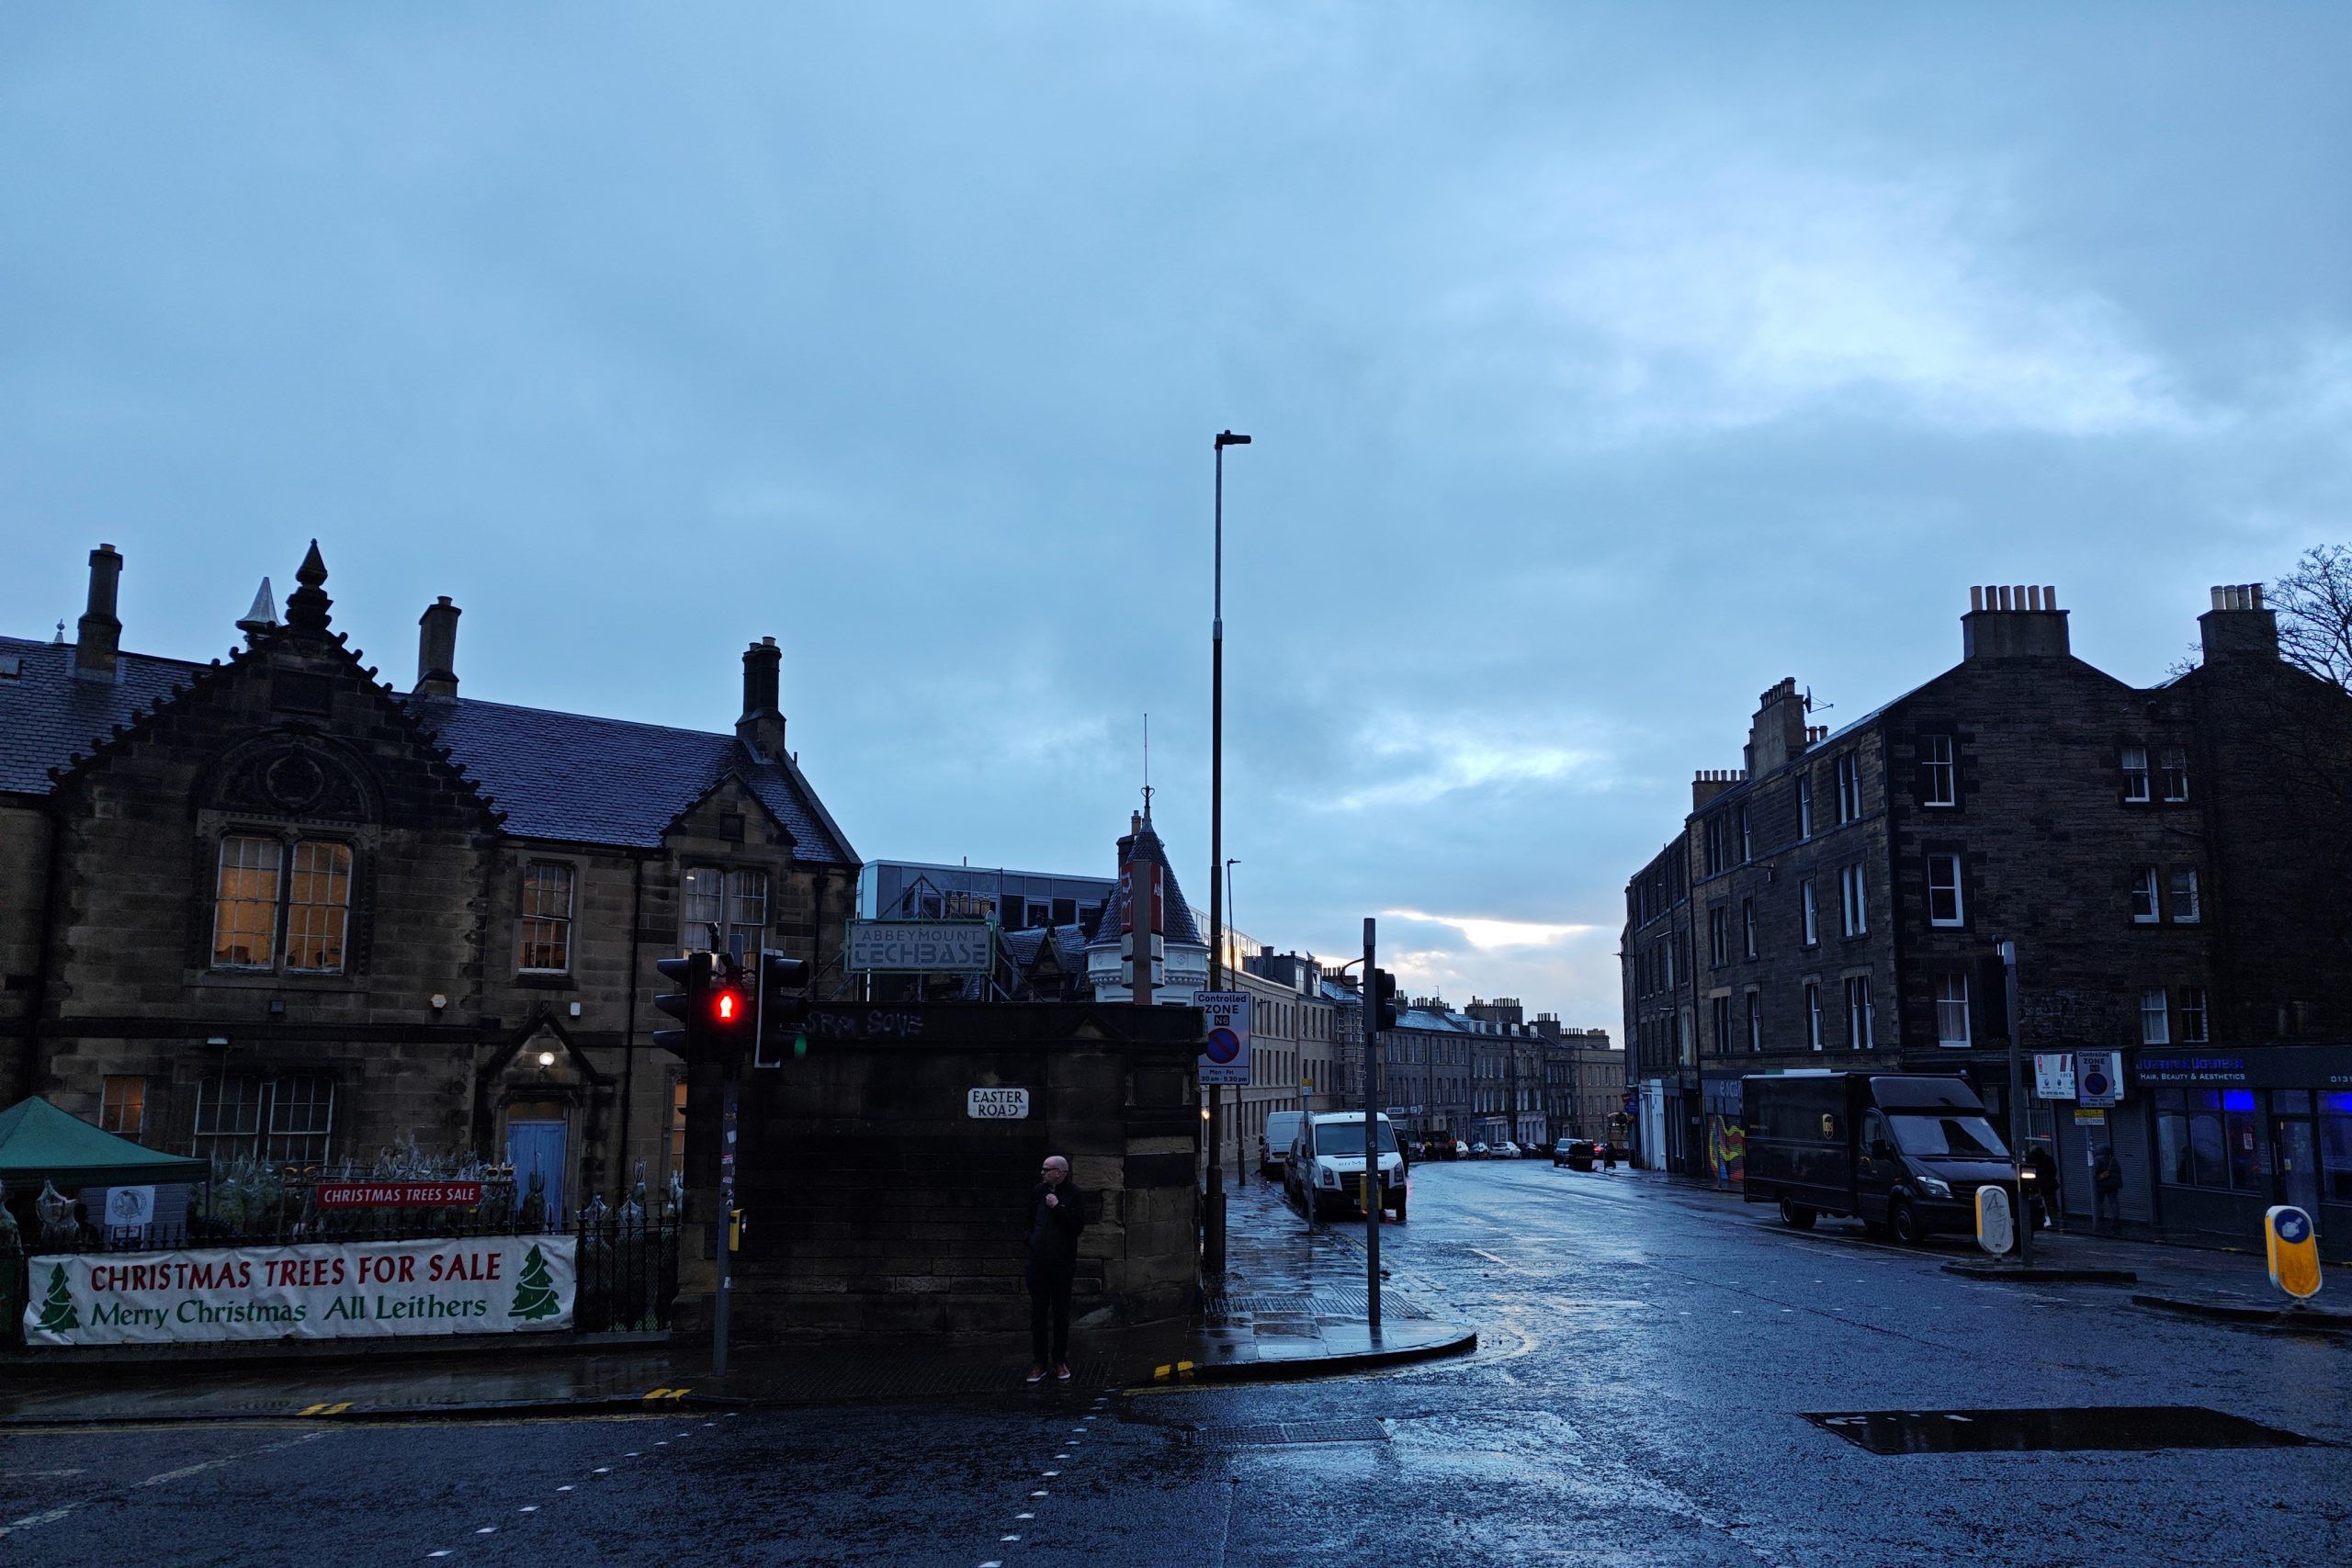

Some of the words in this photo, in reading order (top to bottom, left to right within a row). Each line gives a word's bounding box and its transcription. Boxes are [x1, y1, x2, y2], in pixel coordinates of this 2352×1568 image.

[862, 930, 979, 942] ABBEYMOUNT
[854, 942, 986, 964] TECHBASE
[1198, 994, 1247, 1002] Controlled
[1204, 1005, 1239, 1014] ZONE
[1215, 1017, 1229, 1025] N6
[973, 1090, 1023, 1102] EASTER
[978, 1104, 1018, 1116] ROAD
[323, 1189, 401, 1202] CHRISTMAS
[406, 1188, 442, 1201] TREES
[446, 1188, 475, 1201] SALE
[91, 1261, 251, 1292] CHRISTMAS
[265, 1258, 345, 1287] TREES
[358, 1255, 415, 1284] FOR
[428, 1253, 502, 1282] SALE
[90, 1303, 169, 1330] Merry
[176, 1299, 307, 1324] Christmas
[323, 1296, 367, 1320] All
[375, 1294, 487, 1320] Leithers
